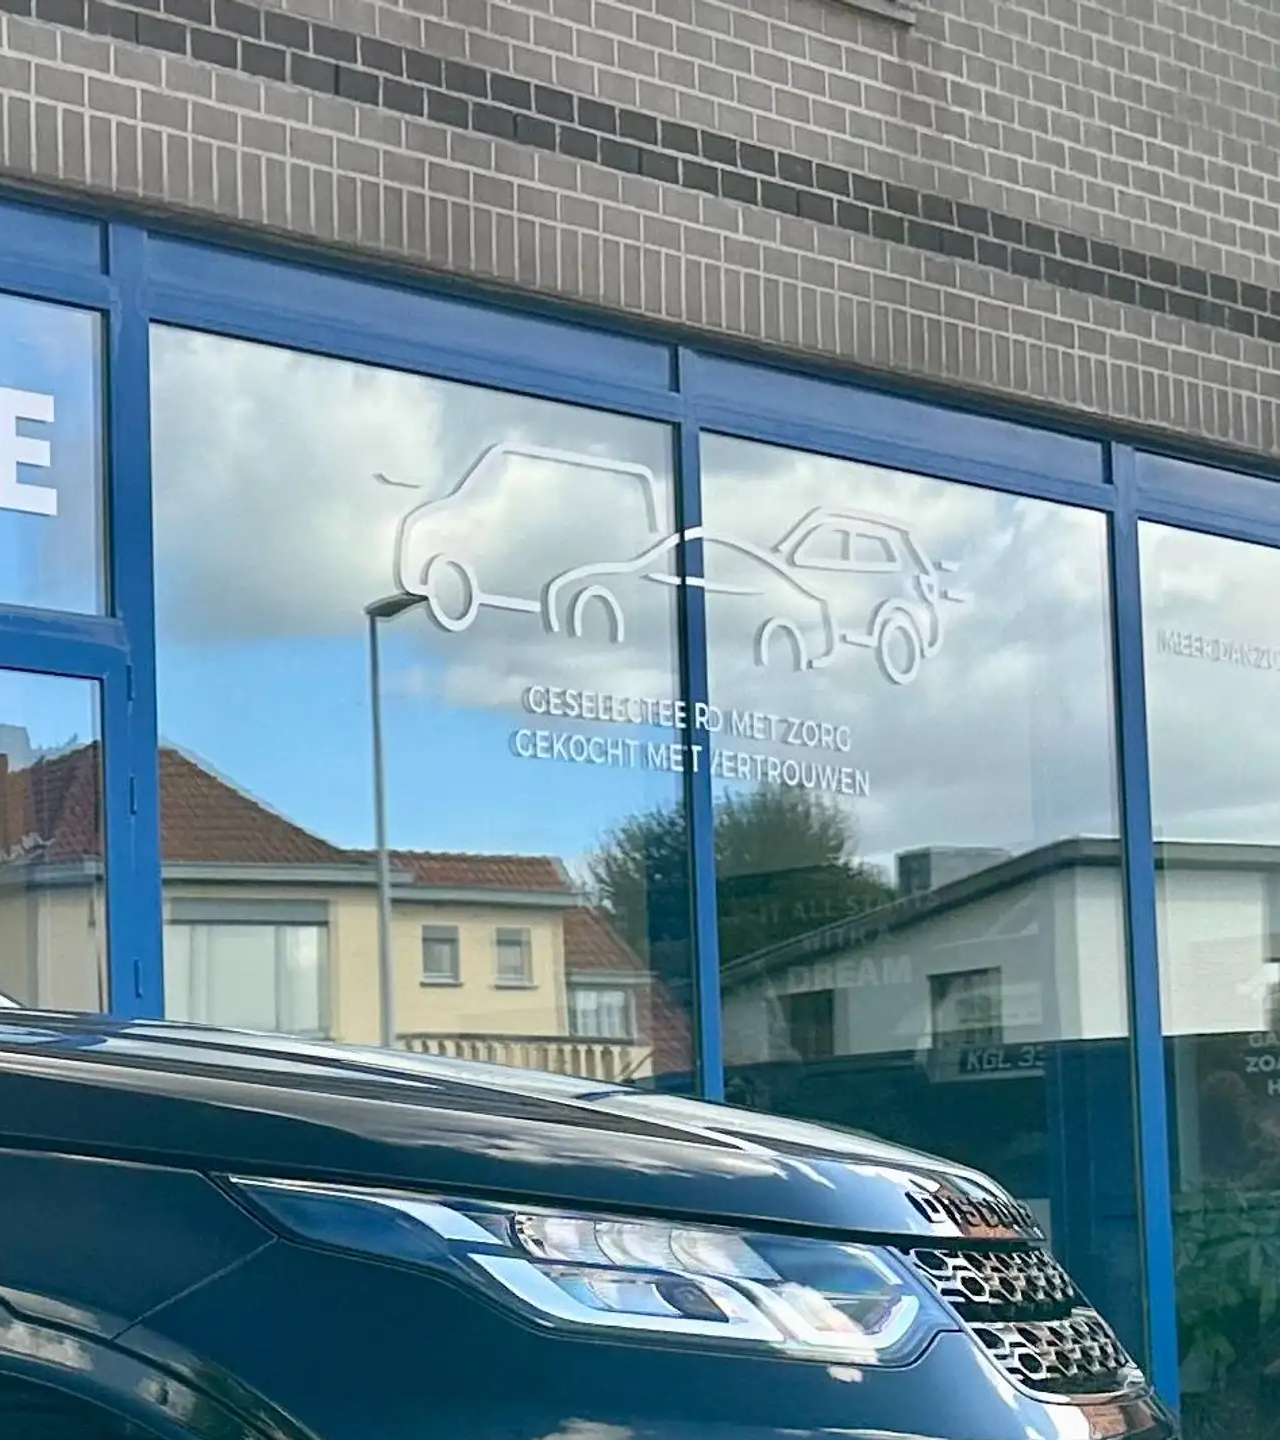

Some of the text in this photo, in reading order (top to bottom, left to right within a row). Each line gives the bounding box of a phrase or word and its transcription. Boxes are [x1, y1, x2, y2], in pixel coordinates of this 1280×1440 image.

[527, 684, 723, 732] GESELECTEERD
[731, 708, 780, 741] MET
[514, 728, 640, 768] GEKOCHT
[647, 741, 703, 773] MET
[787, 955, 913, 991] DREAM
[966, 1048, 1012, 1071] KGL
[1244, 1055, 1280, 1073] ZO
